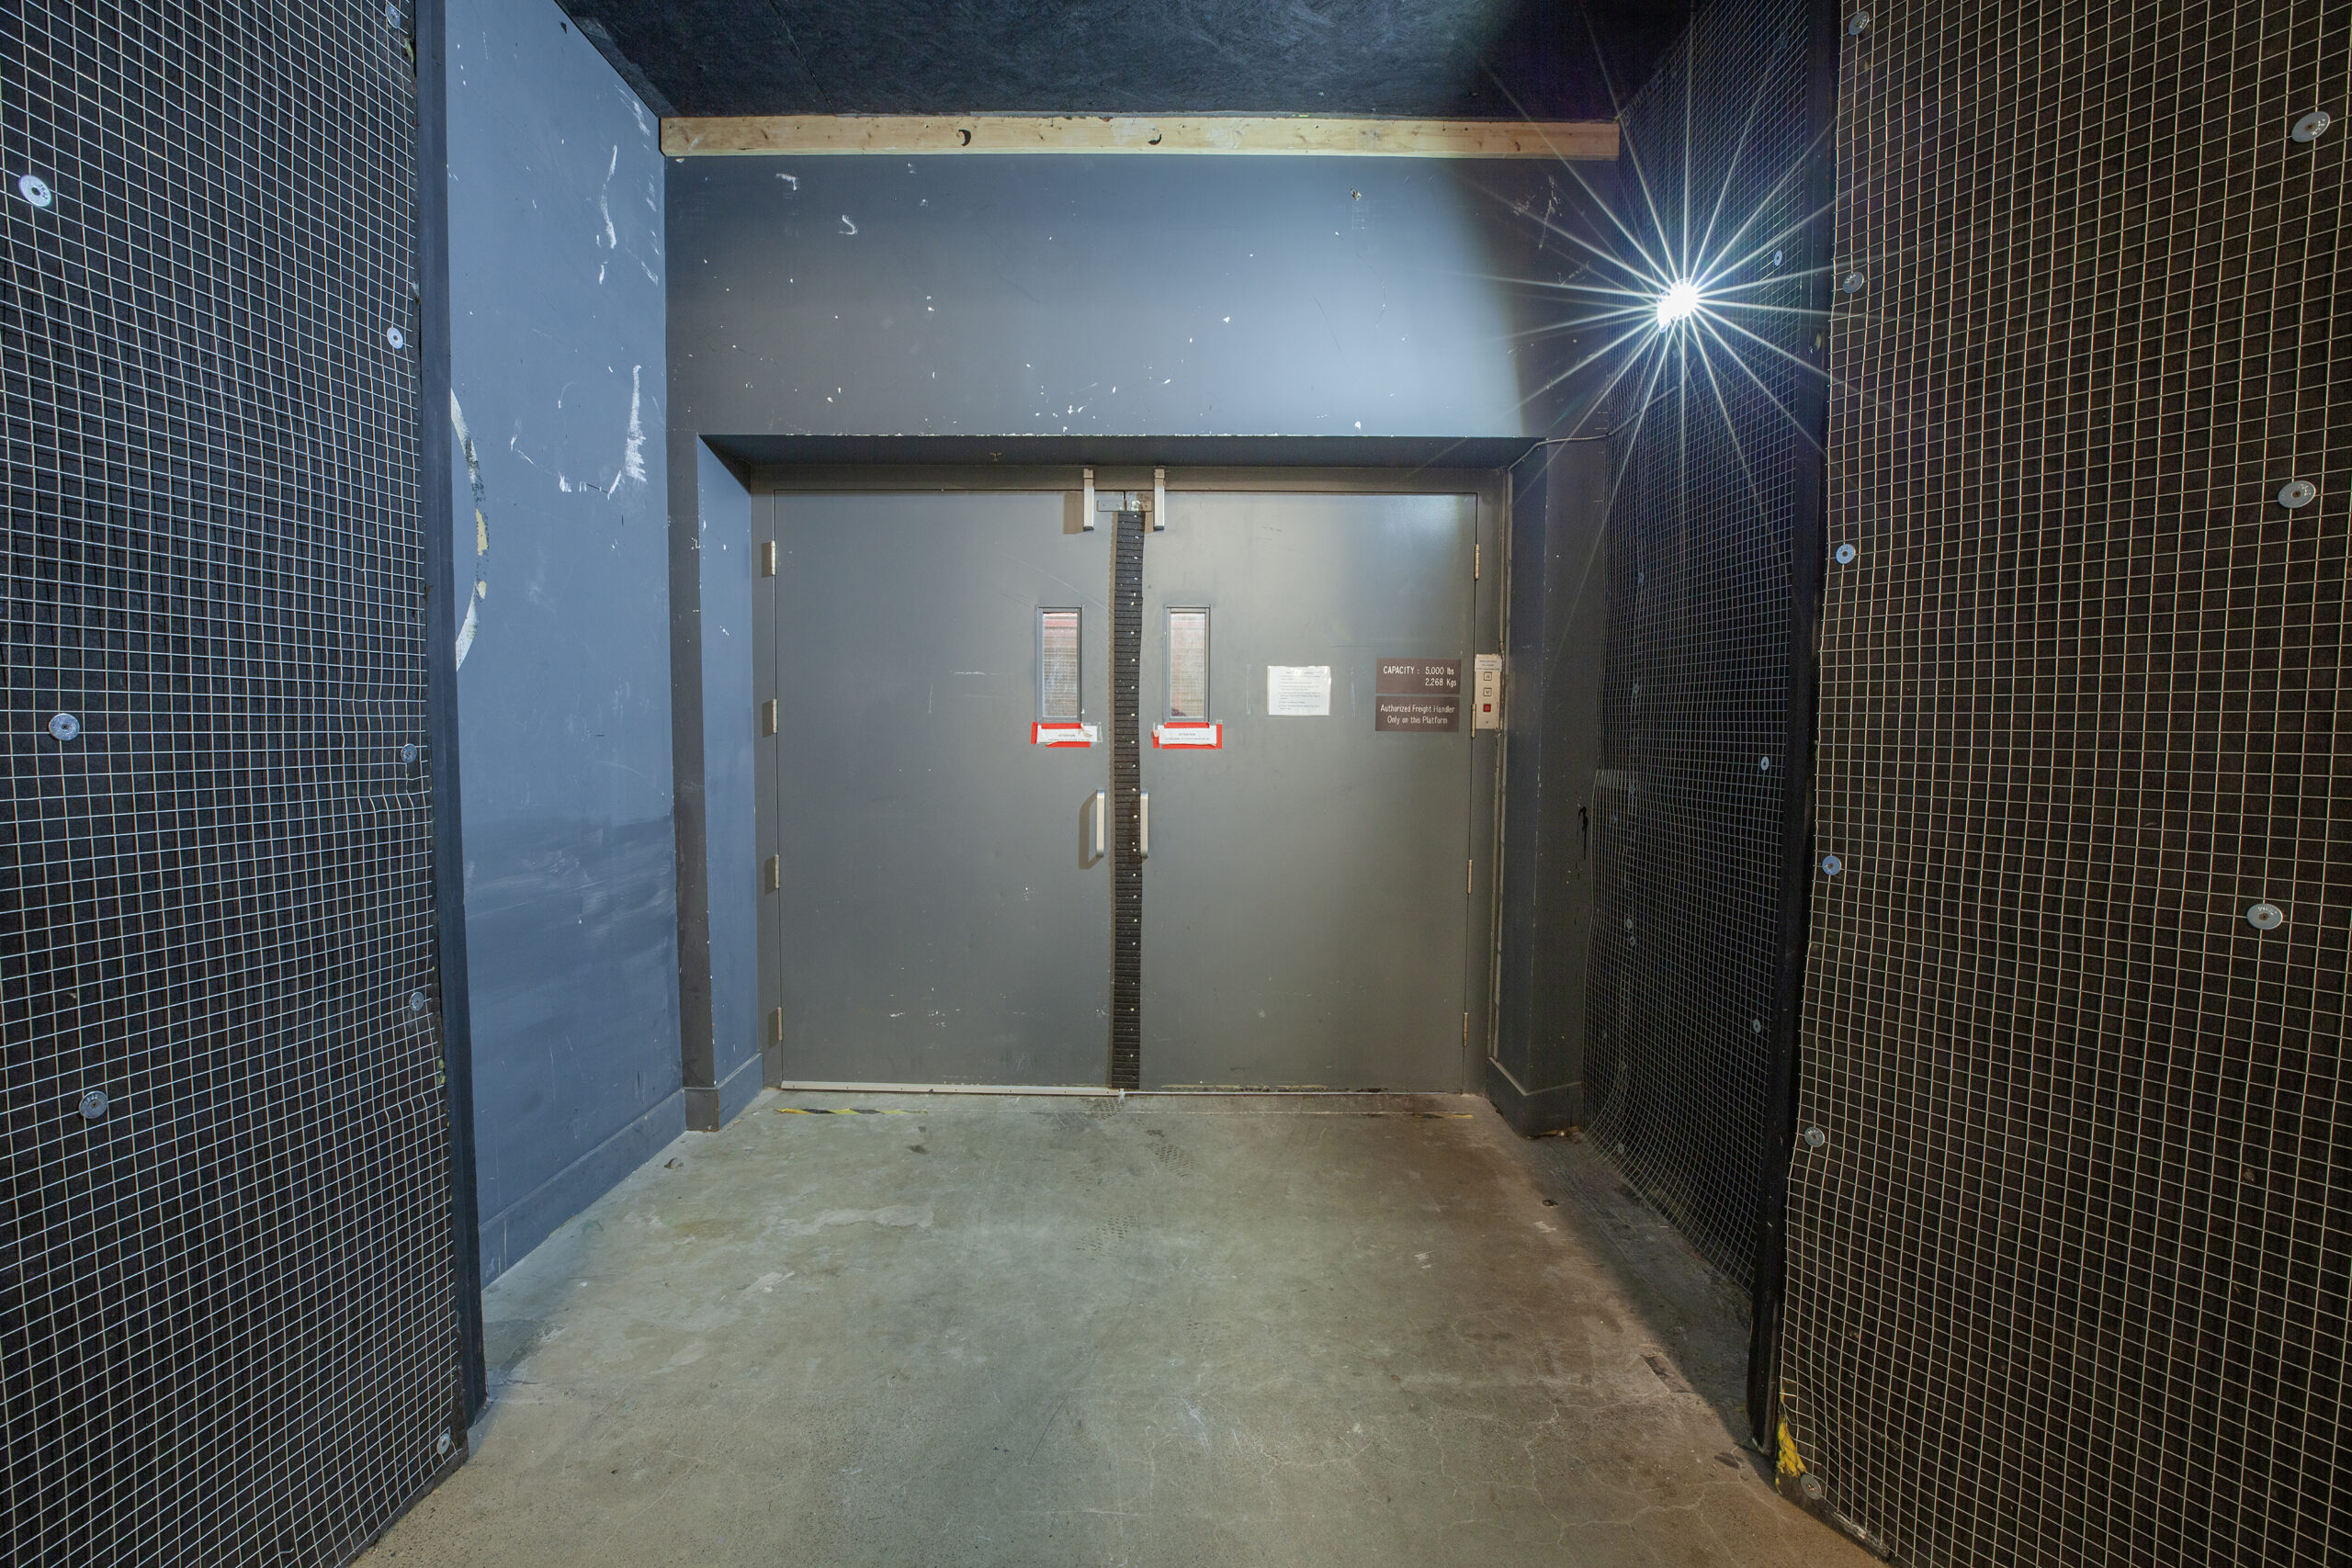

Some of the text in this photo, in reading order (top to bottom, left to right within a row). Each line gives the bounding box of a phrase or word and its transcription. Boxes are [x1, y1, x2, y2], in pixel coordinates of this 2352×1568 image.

[1383, 665, 1415, 674] CAPACITY
[1446, 667, 1454, 675] lbs
[1446, 678, 1457, 687] Kgs
[1380, 704, 1455, 714] Authorized Freight Handler
[1386, 715, 1400, 725] Only
[1410, 716, 1421, 724] this
[1422, 716, 1448, 724] Platform
